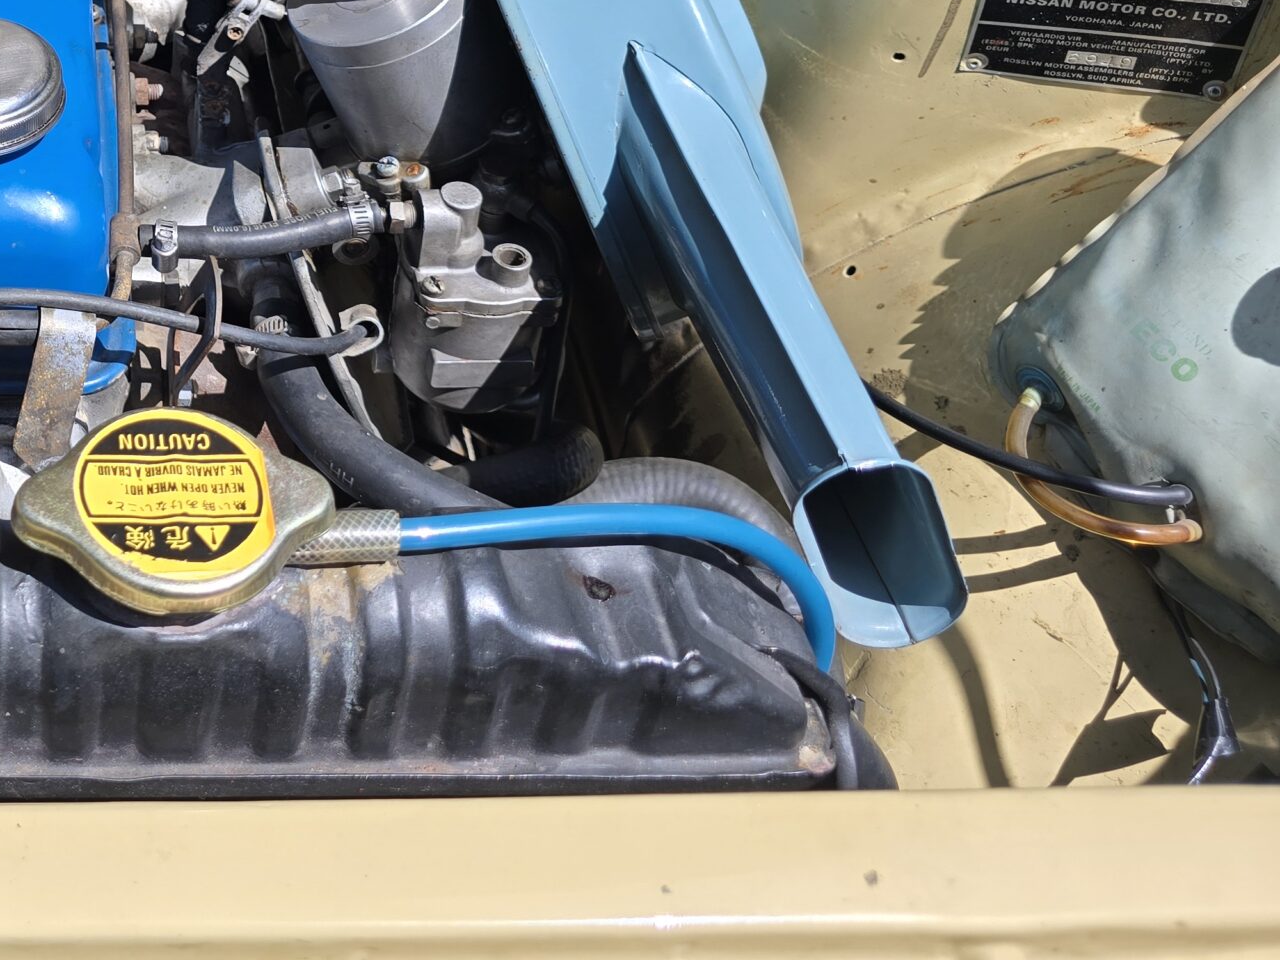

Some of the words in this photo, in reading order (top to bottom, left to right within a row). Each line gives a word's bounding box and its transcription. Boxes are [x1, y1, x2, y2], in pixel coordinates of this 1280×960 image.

[1078, 0, 1148, 16] MOTOR
[1150, 6, 1188, 22] CO.,
[1192, 11, 1233, 25] LTD.
[1129, 20, 1163, 31] JAPAN
[1010, 30, 1066, 40] VERVAARDIG
[985, 45, 1010, 53] DEUR
[1018, 36, 1054, 45] DATSUN
[1056, 40, 1089, 48] MOTOR
[1090, 43, 1126, 52] VEHICLE
[1112, 39, 1187, 53] MANUFACTURED
[1187, 47, 1207, 55] FOR
[1003, 57, 1042, 67] ROSSLYN
[1044, 61, 1076, 70] MOTOR
[1078, 65, 1134, 77] ASSEMBLERS
[1087, 74, 1108, 82] SUID
[1110, 75, 1144, 86] AFRIKA.
[118, 432, 210, 451] CAUTION
[144, 464, 183, 478] OUVRIR
[185, 464, 227, 476] JAMAIS
[228, 464, 243, 476] NE
[120, 483, 144, 495] HOT.
[146, 481, 178, 496] WHEN
[180, 481, 208, 494] OPEN
[210, 481, 245, 495] NEVER
[123, 524, 192, 551] 危険
